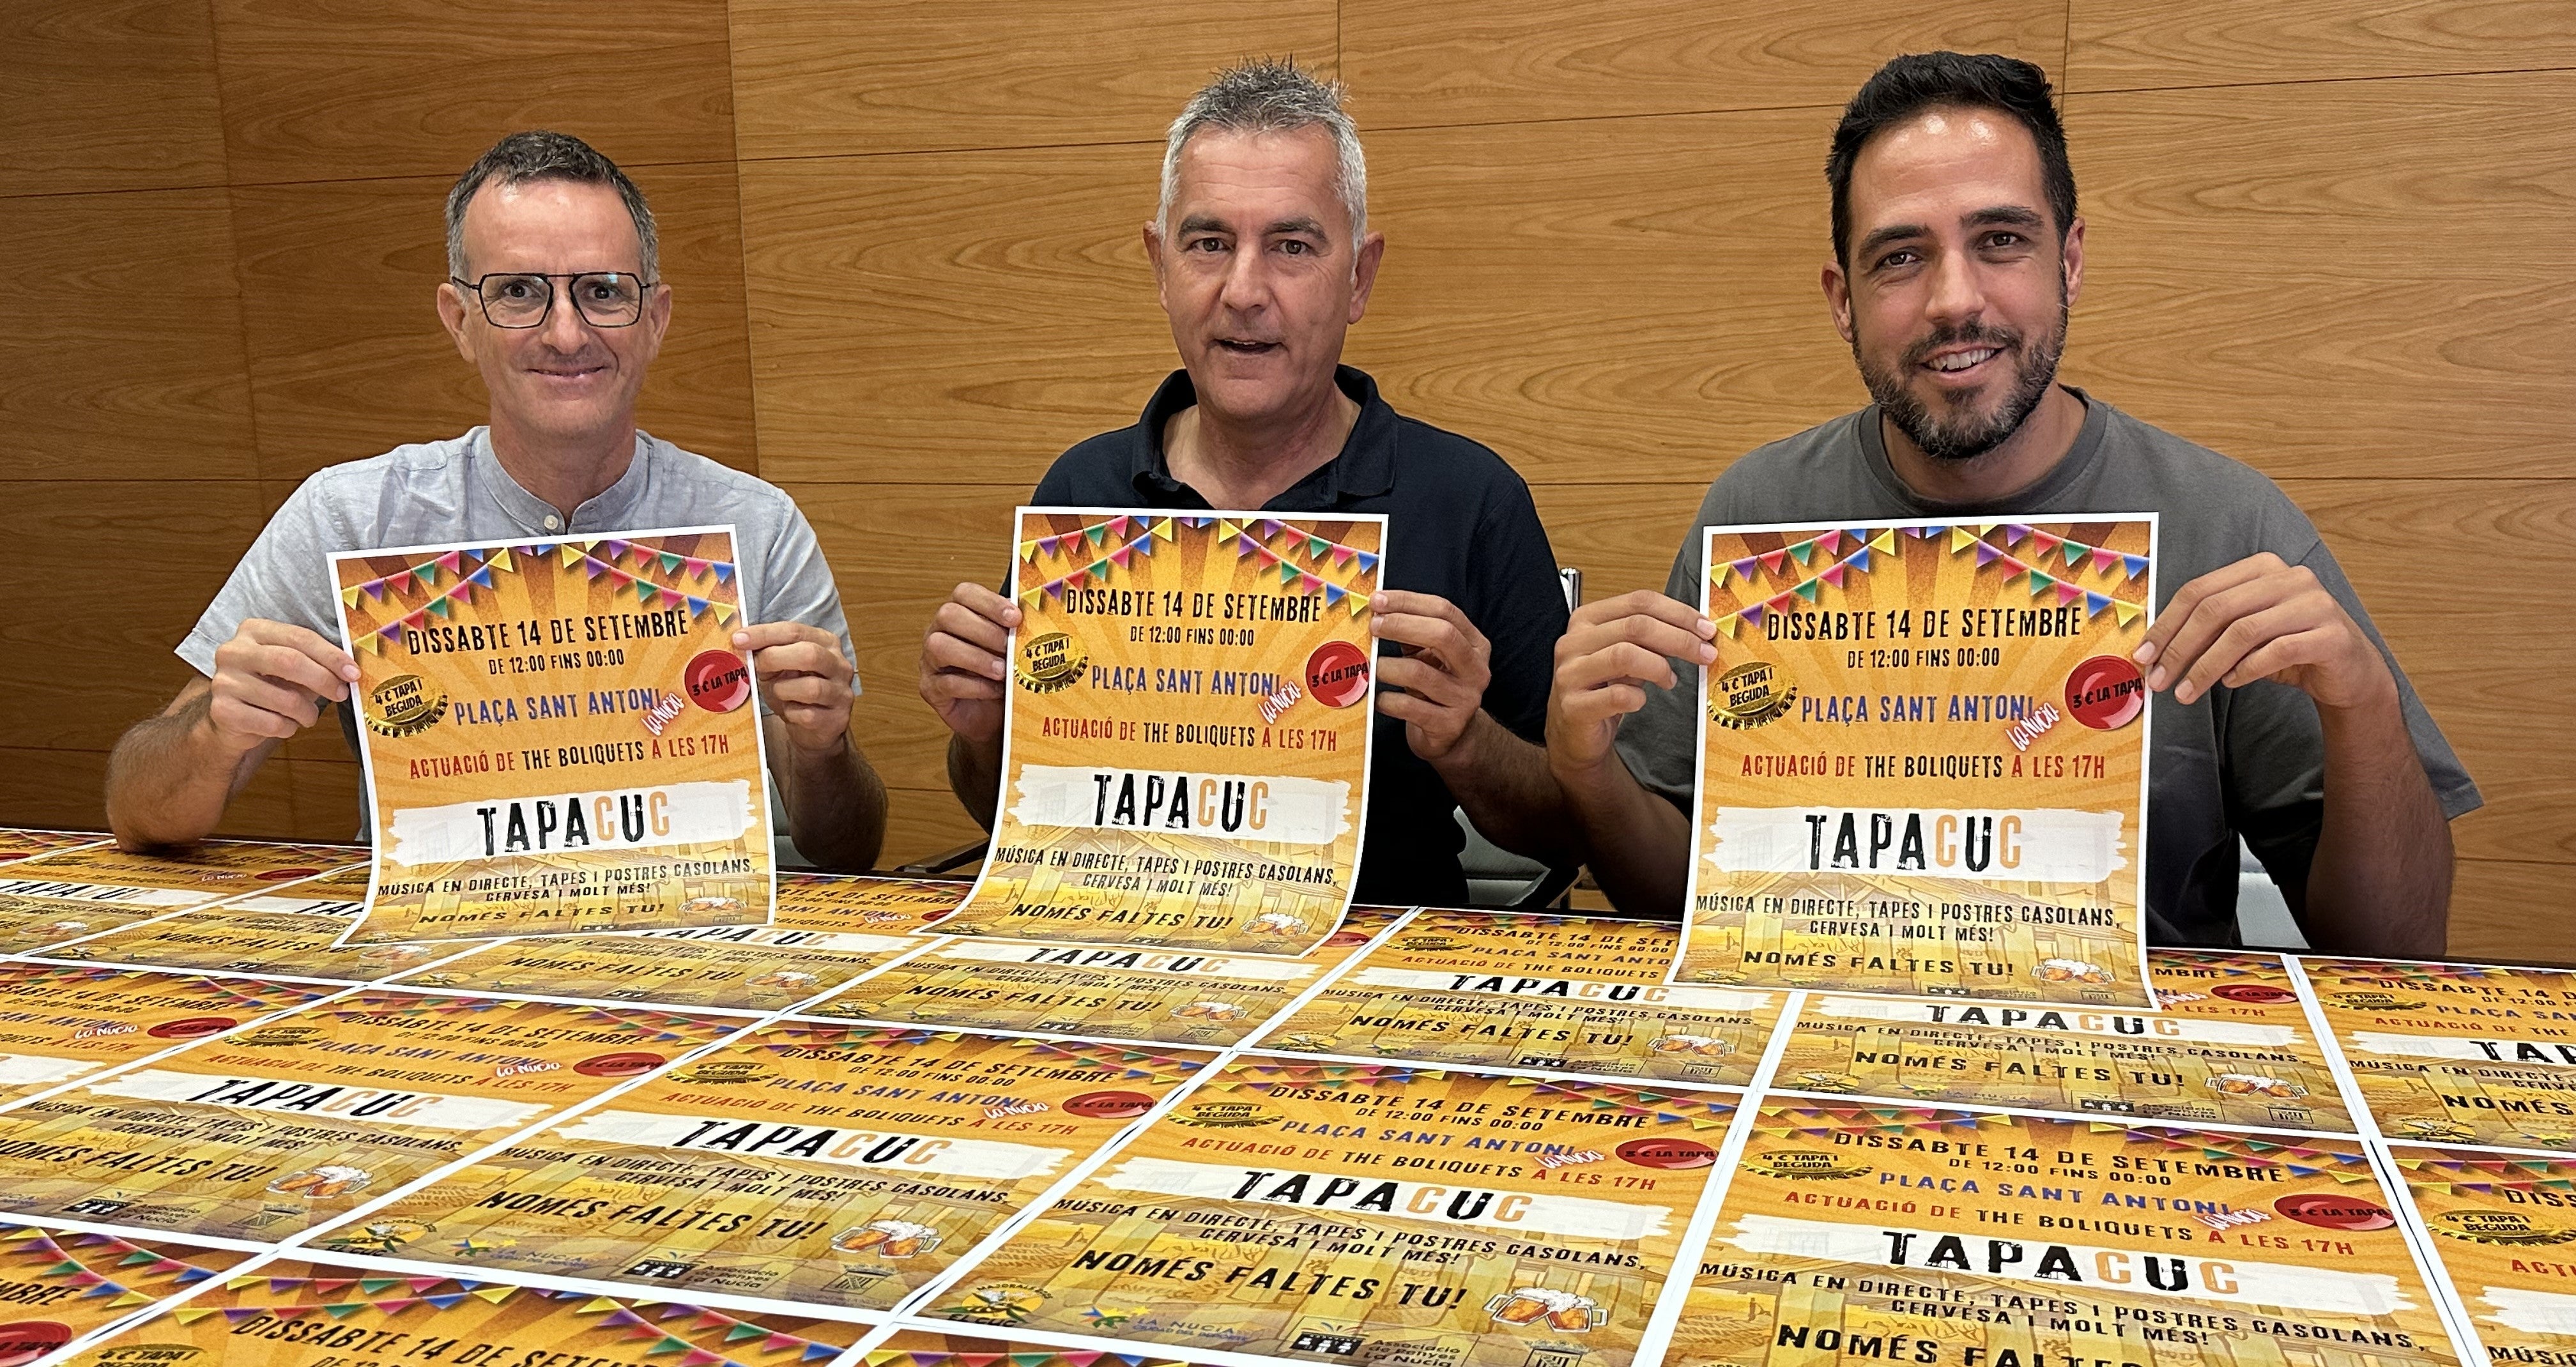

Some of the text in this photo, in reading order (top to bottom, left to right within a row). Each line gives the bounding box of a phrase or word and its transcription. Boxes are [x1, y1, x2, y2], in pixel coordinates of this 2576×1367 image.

[1066, 589, 1321, 623] DISSABTE 14 DE SETEMBRE
[407, 610, 689, 656] DISSABTE 14 DE SETEMBRE
[1130, 627, 1255, 646] DE 12:00 FINS 00:00
[1767, 607, 2082, 641] DISSABTE 14 DE SETEMBRE
[489, 649, 624, 675] DE 12:00 FINS 00:00
[1847, 648, 2000, 668] DE 12:00 FINS 00:00
[1092, 665, 1281, 697] PLAÇA SANT ANTONI
[1721, 666, 1774, 693] 4 € TAPA I
[1729, 684, 1770, 706] BEGUDA
[2073, 676, 2143, 709] 3 € LA TAPA
[454, 688, 661, 726] PLAÇA SANT ANTONI
[1802, 694, 2035, 725] PLAÇA SANT ANTONI
[1041, 716, 1337, 751] ACTUACIÓ DE THE BOLIQUETS A LES 17H
[410, 735, 729, 779] ACTUACIÓ DE THE BOLIQUETS A LES 17H
[1741, 752, 2104, 780] ACTUACIÓ DE THE BOLIQUETS A LES 17H
[1094, 774, 1268, 832] TAPACUC
[477, 791, 671, 856] TAPACUC
[1805, 813, 2021, 872] TAPACUC
[378, 859, 756, 896] MÚSICA EN DIRECTE, TAPES I POSTRES CASOLANS,
[994, 845, 1338, 887] MÚSICA EN DIRECTE, TAPES I POSTRES CASOLANS,
[486, 881, 650, 902] CERVESA I MOLT MÉS!
[1083, 874, 1232, 897] CERVESA I MOLT MÉS!
[418, 903, 664, 924] NOMÉS FALTES TU!
[1009, 903, 1233, 929] NOMÉS FALTES TU!
[1696, 894, 2120, 928] MÚSICA EN DIRECTE, TAPES I POSTRES CASOLANS,
[1809, 920, 1994, 942] CERVESA I MOLT MÉS!
[1024, 948, 1231, 974] TAPACUC
[1743, 950, 2014, 975] NOMÉS FALTES TU!
[905, 985, 1162, 1012] NOMÉS FALTES TU!
[1449, 974, 1668, 1002] TAPACUC
[2379, 980, 2549, 998] DISSABTE 14
[1350, 1016, 1633, 1047] NOMÉS FALTES TU!
[1926, 1005, 2179, 1036] TAPACUC
[1855, 1051, 2184, 1087] NOMÉS FALTES TU!
[187, 1080, 445, 1118] TAPACUC
[672, 1120, 953, 1164] TAPACUC
[1835, 1133, 2285, 1183] DISSABTE 14 DE SETEMBRE
[1231, 1170, 1533, 1223] TAPACUC
[1880, 1172, 2231, 1214] PLAÇA SANT ANTONI
[475, 1191, 829, 1241] NOMÉS FALTES TU!
[1072, 1249, 1468, 1310] NOMÉS FALTES TU!
[1882, 1231, 2239, 1294] TAPACUC
[231, 1316, 410, 1354] DISSABTE
